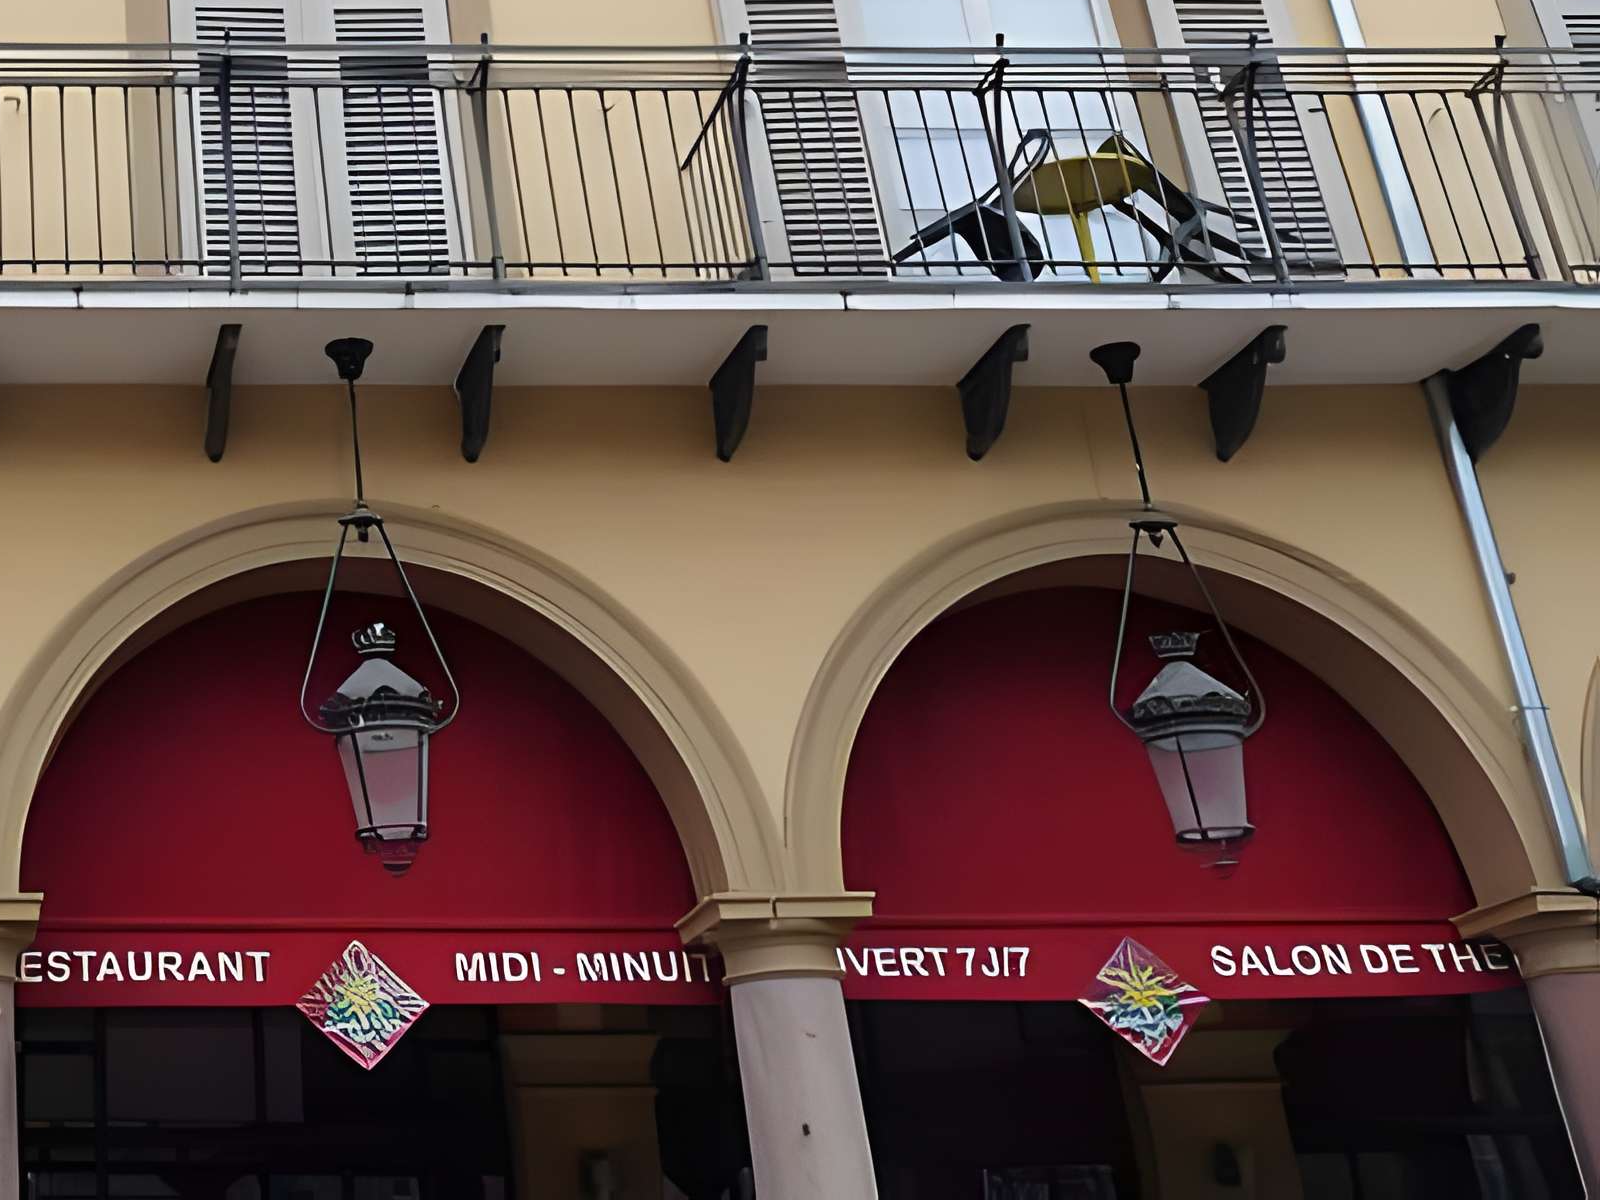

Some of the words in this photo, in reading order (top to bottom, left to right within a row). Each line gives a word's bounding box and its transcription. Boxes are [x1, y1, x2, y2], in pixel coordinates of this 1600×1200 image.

[455, 951, 542, 983] MIDI
[836, 946, 949, 978] VERT
[1210, 944, 1353, 977] SALON
[1359, 943, 1421, 974] DE
